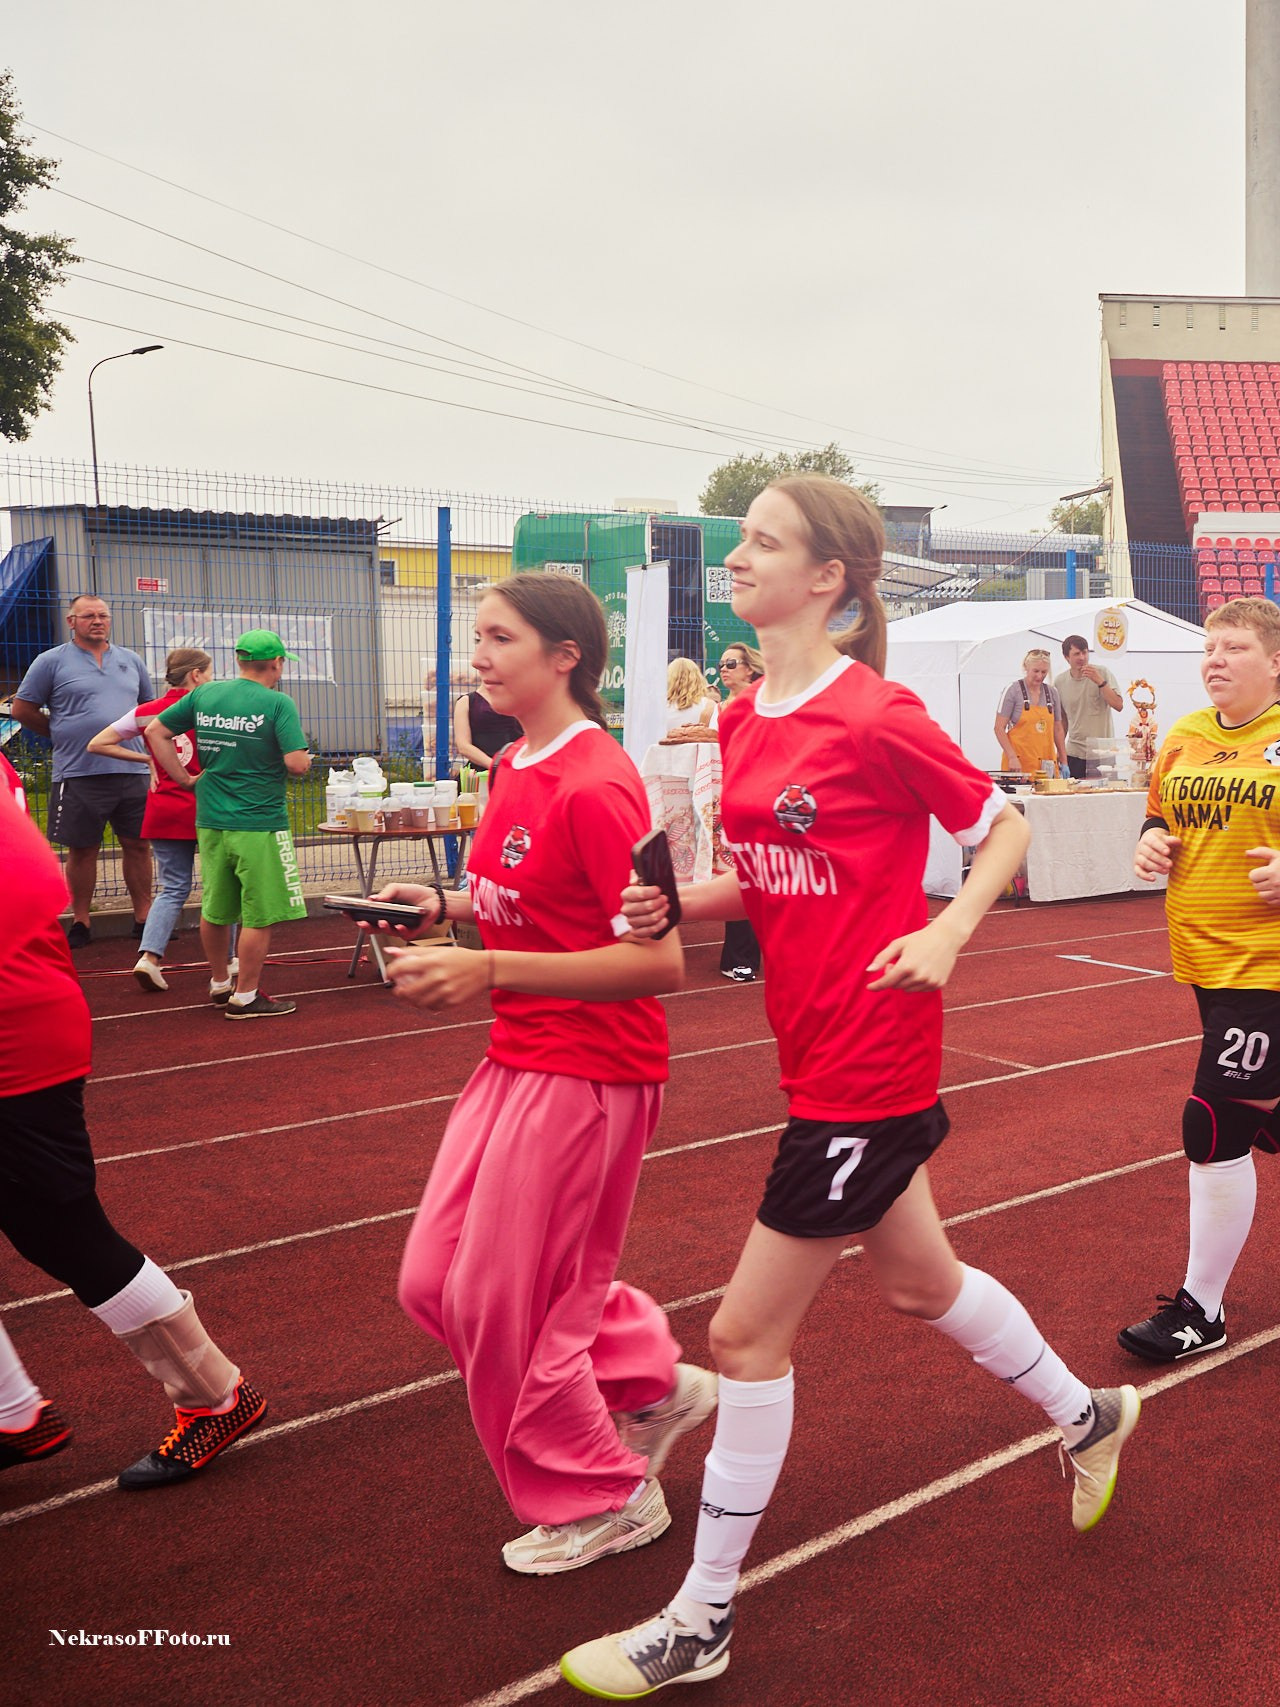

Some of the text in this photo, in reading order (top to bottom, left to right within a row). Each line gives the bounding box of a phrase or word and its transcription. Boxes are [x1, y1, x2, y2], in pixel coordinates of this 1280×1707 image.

[196, 711, 257, 733] Herbalife
[1160, 776, 1276, 811] УТБОЛЬНАЯ
[1172, 803, 1232, 830] МАМА!
[275, 830, 305, 908] ERBALIFE
[1217, 1027, 1270, 1072] 20
[825, 1136, 871, 1201] 7
